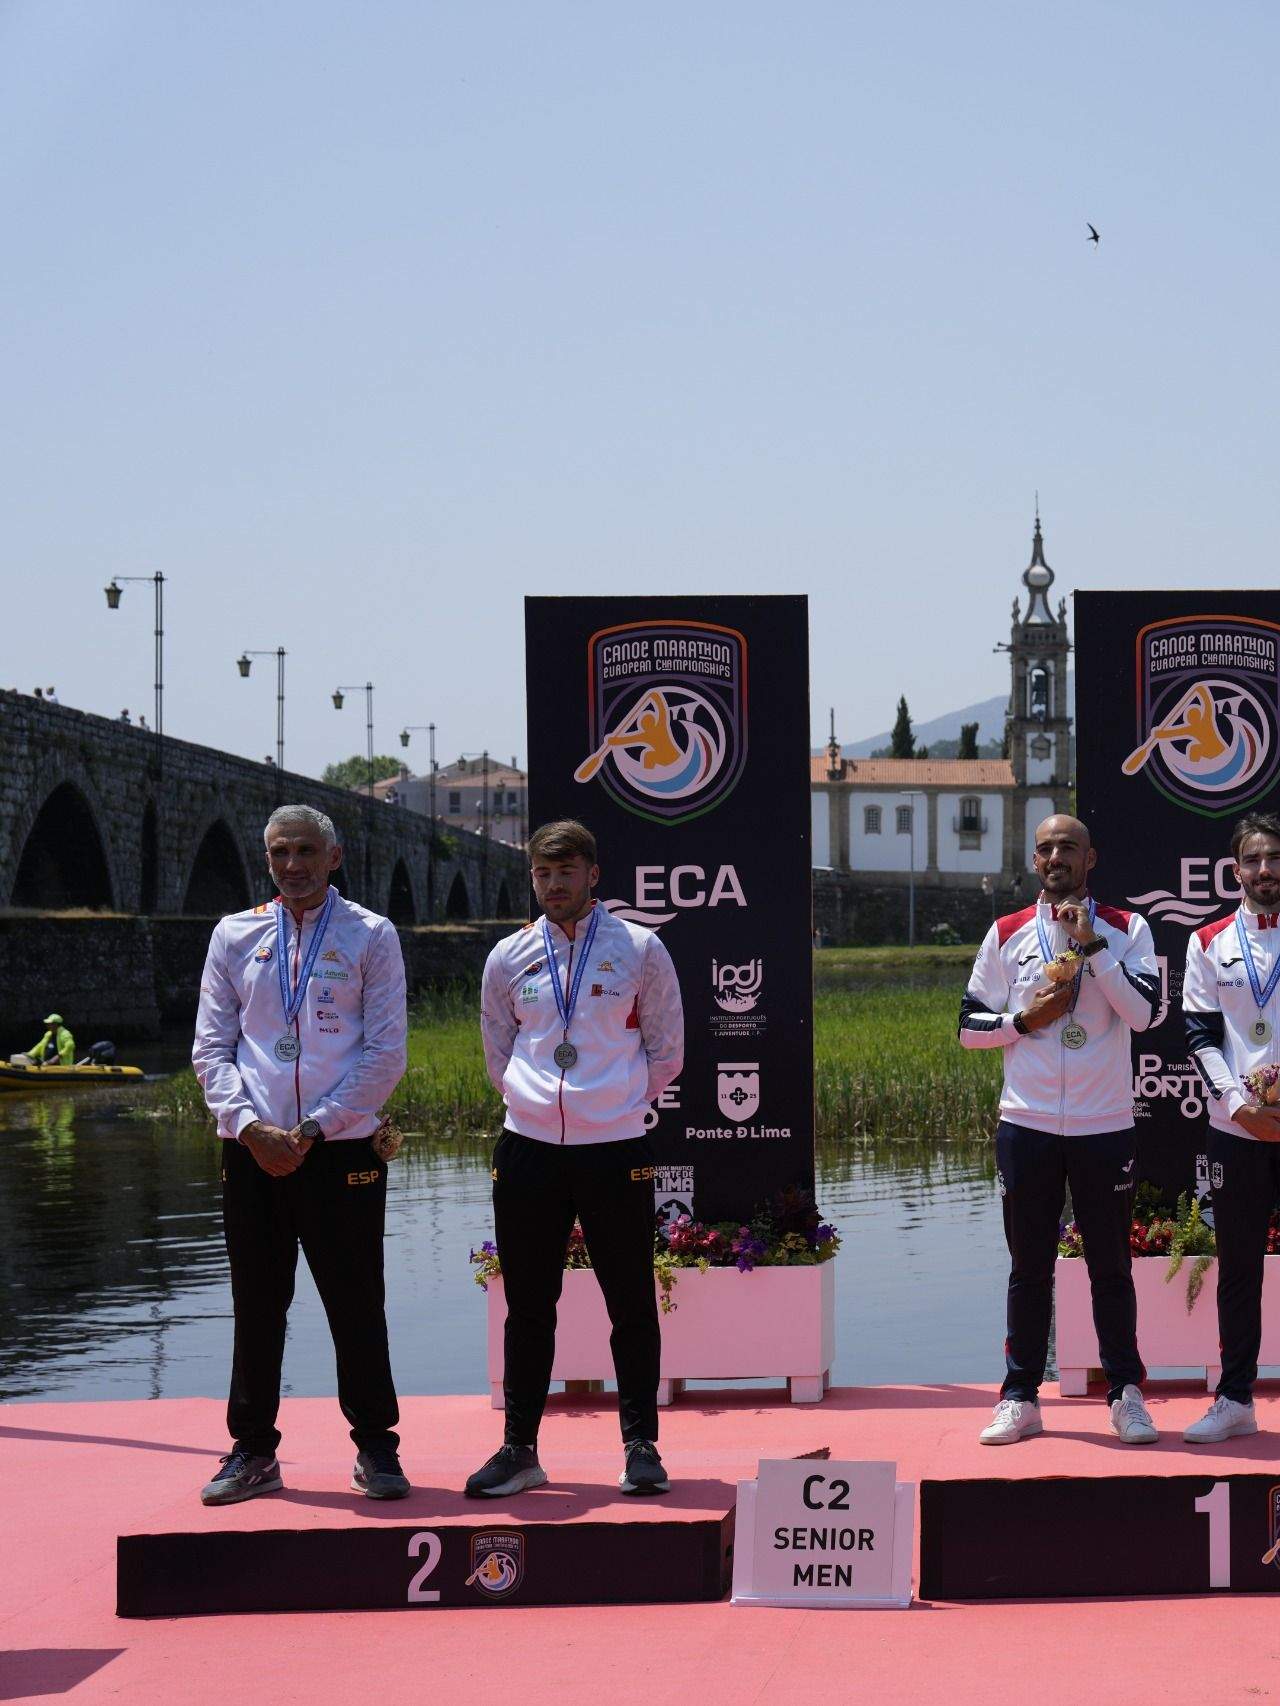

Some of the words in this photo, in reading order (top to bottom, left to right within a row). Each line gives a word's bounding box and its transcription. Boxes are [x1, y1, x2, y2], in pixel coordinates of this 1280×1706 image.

[603, 640, 649, 665] CANOE
[653, 639, 730, 664] MARATHON
[1151, 635, 1196, 658] CANOE
[1200, 634, 1275, 658] MARATHON
[603, 660, 652, 679] EUROPEAN
[655, 659, 731, 678] CHAMPIONSHIPS
[1151, 653, 1198, 672] EUROPEAN
[1201, 653, 1275, 672] CHAMPIONSHIPS
[636, 864, 747, 908] ECA
[1181, 857, 1245, 899] EC
[686, 1127, 733, 1139] Ponte
[751, 1125, 791, 1138] Lima
[348, 1170, 379, 1184] ESP
[654, 1178, 694, 1191] LIMA
[682, 1170, 694, 1178] DE
[803, 1474, 850, 1510] C2
[774, 1527, 874, 1551] SENIOR
[1194, 1482, 1230, 1588] 1
[407, 1532, 440, 1602] 2
[793, 1564, 853, 1587] MEN
